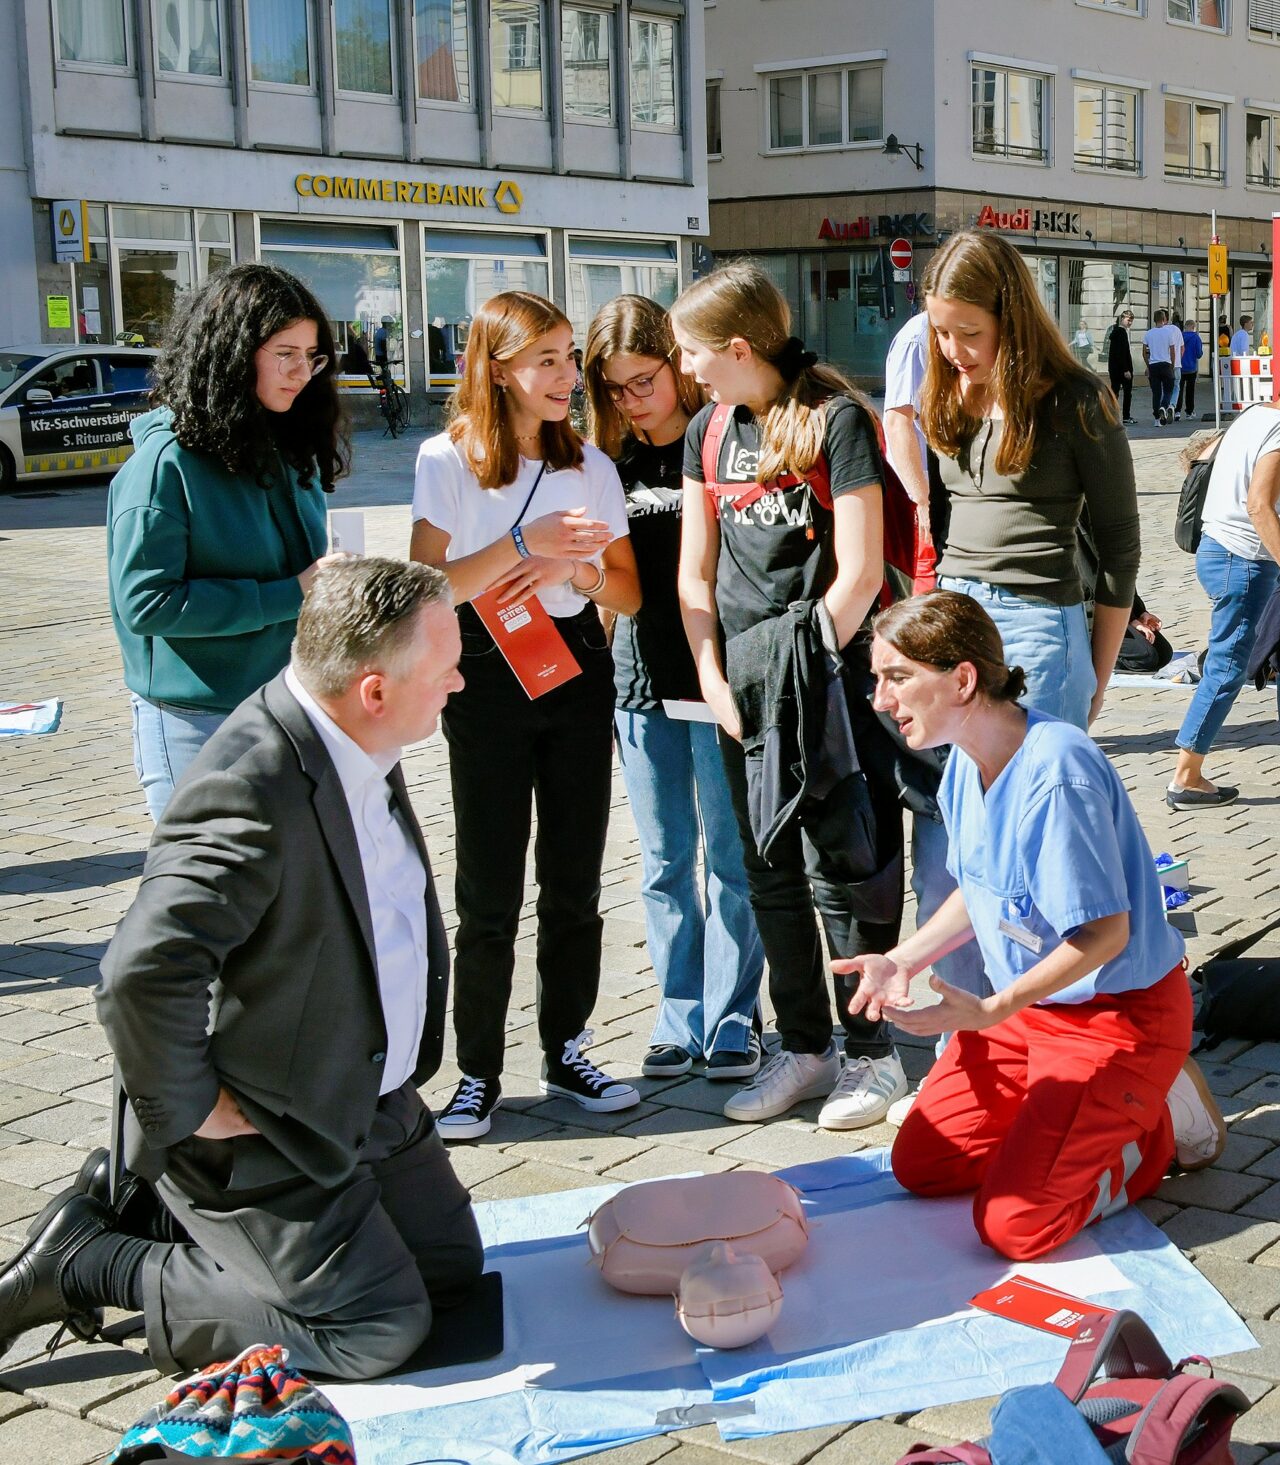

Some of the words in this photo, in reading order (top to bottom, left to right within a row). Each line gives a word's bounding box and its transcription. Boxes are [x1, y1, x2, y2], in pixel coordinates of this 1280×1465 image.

[295, 172, 488, 208] COMMERZBANK
[818, 216, 871, 240] Audi
[876, 212, 934, 237] BKK
[976, 205, 1031, 230] Audi
[1034, 209, 1080, 234] BKK
